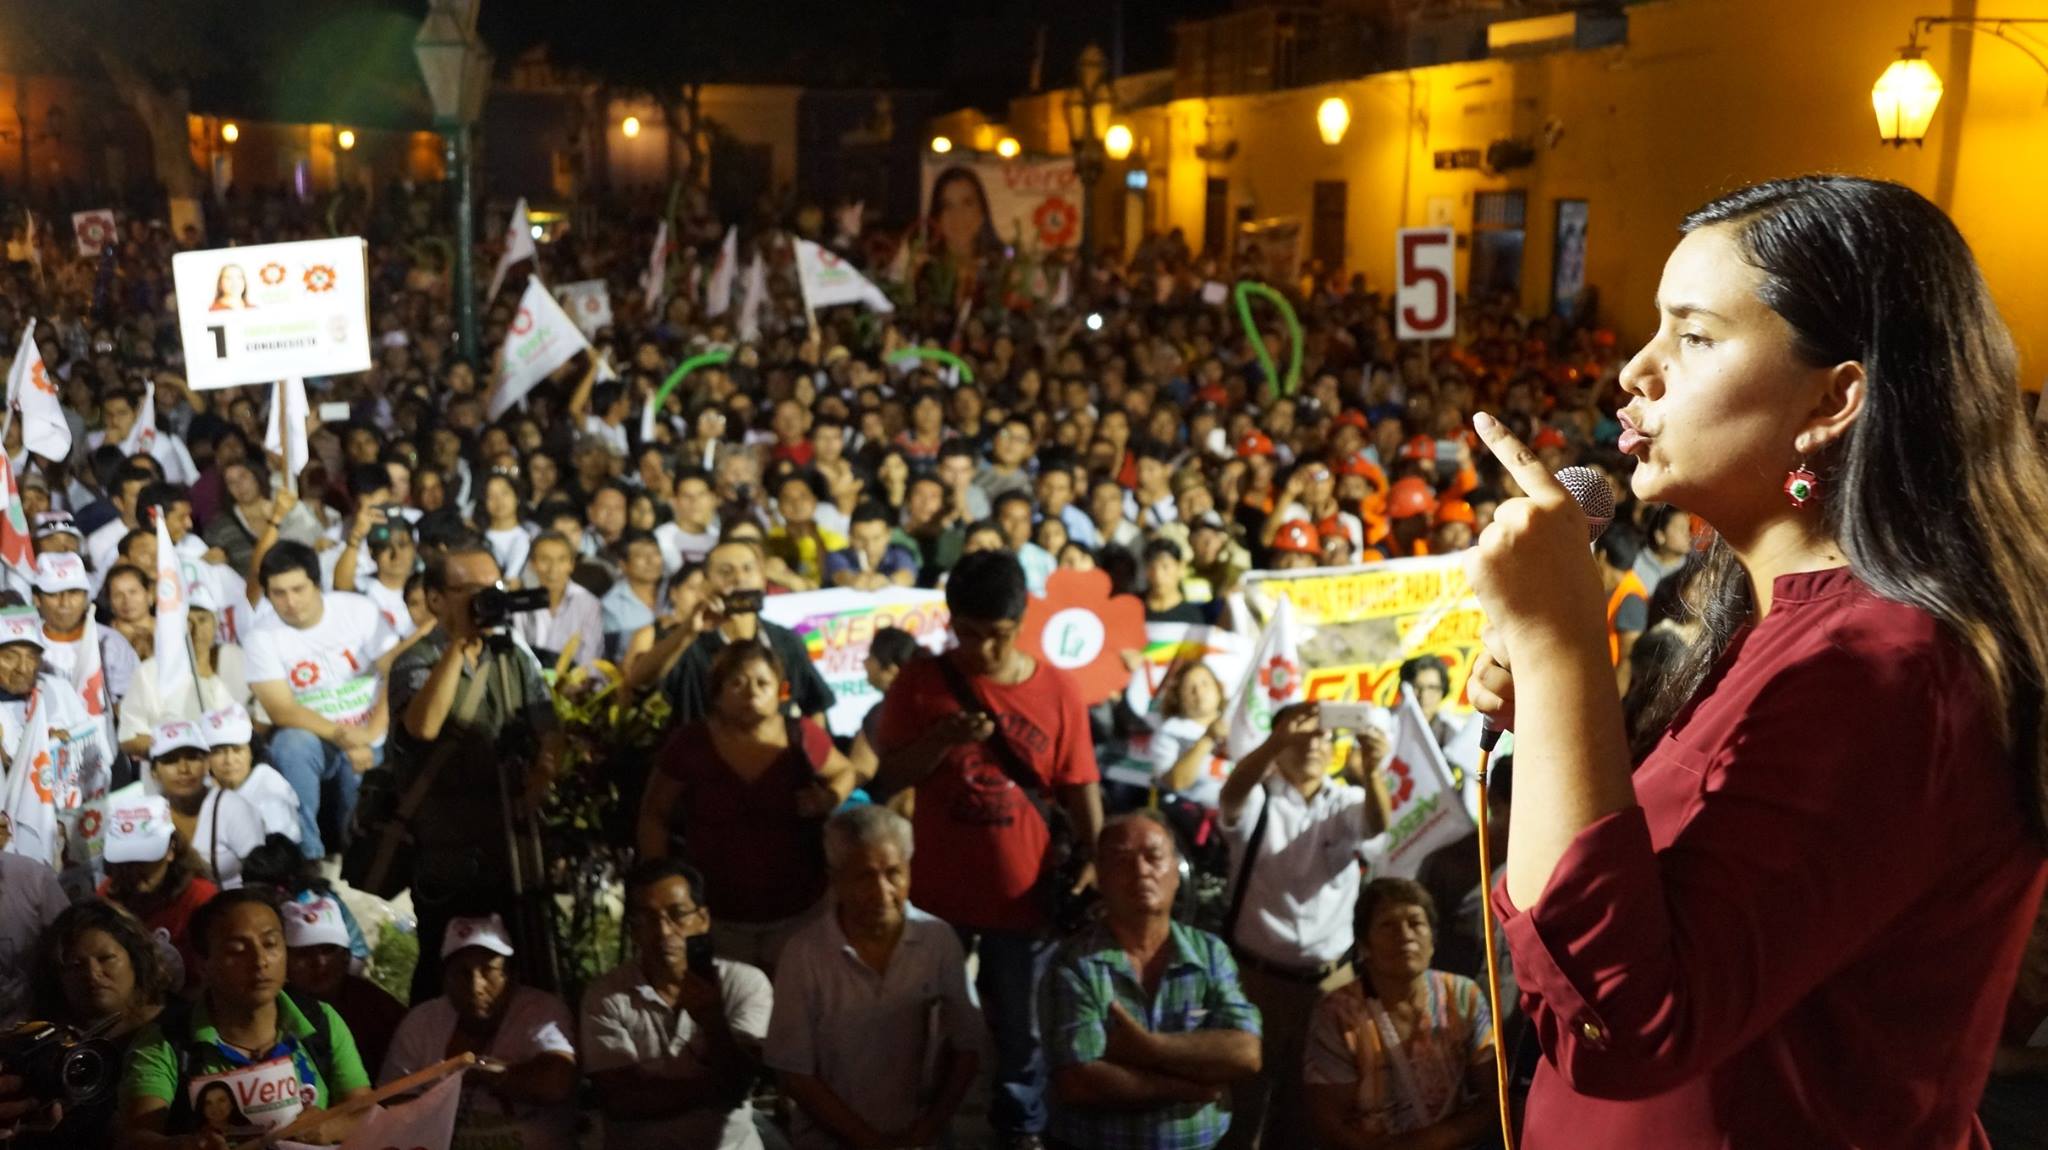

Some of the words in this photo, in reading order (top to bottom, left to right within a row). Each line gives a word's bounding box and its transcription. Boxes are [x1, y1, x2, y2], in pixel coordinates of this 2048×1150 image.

[1403, 233, 1449, 331] 5
[206, 325, 226, 358] 1
[237, 1076, 297, 1106] Vero
